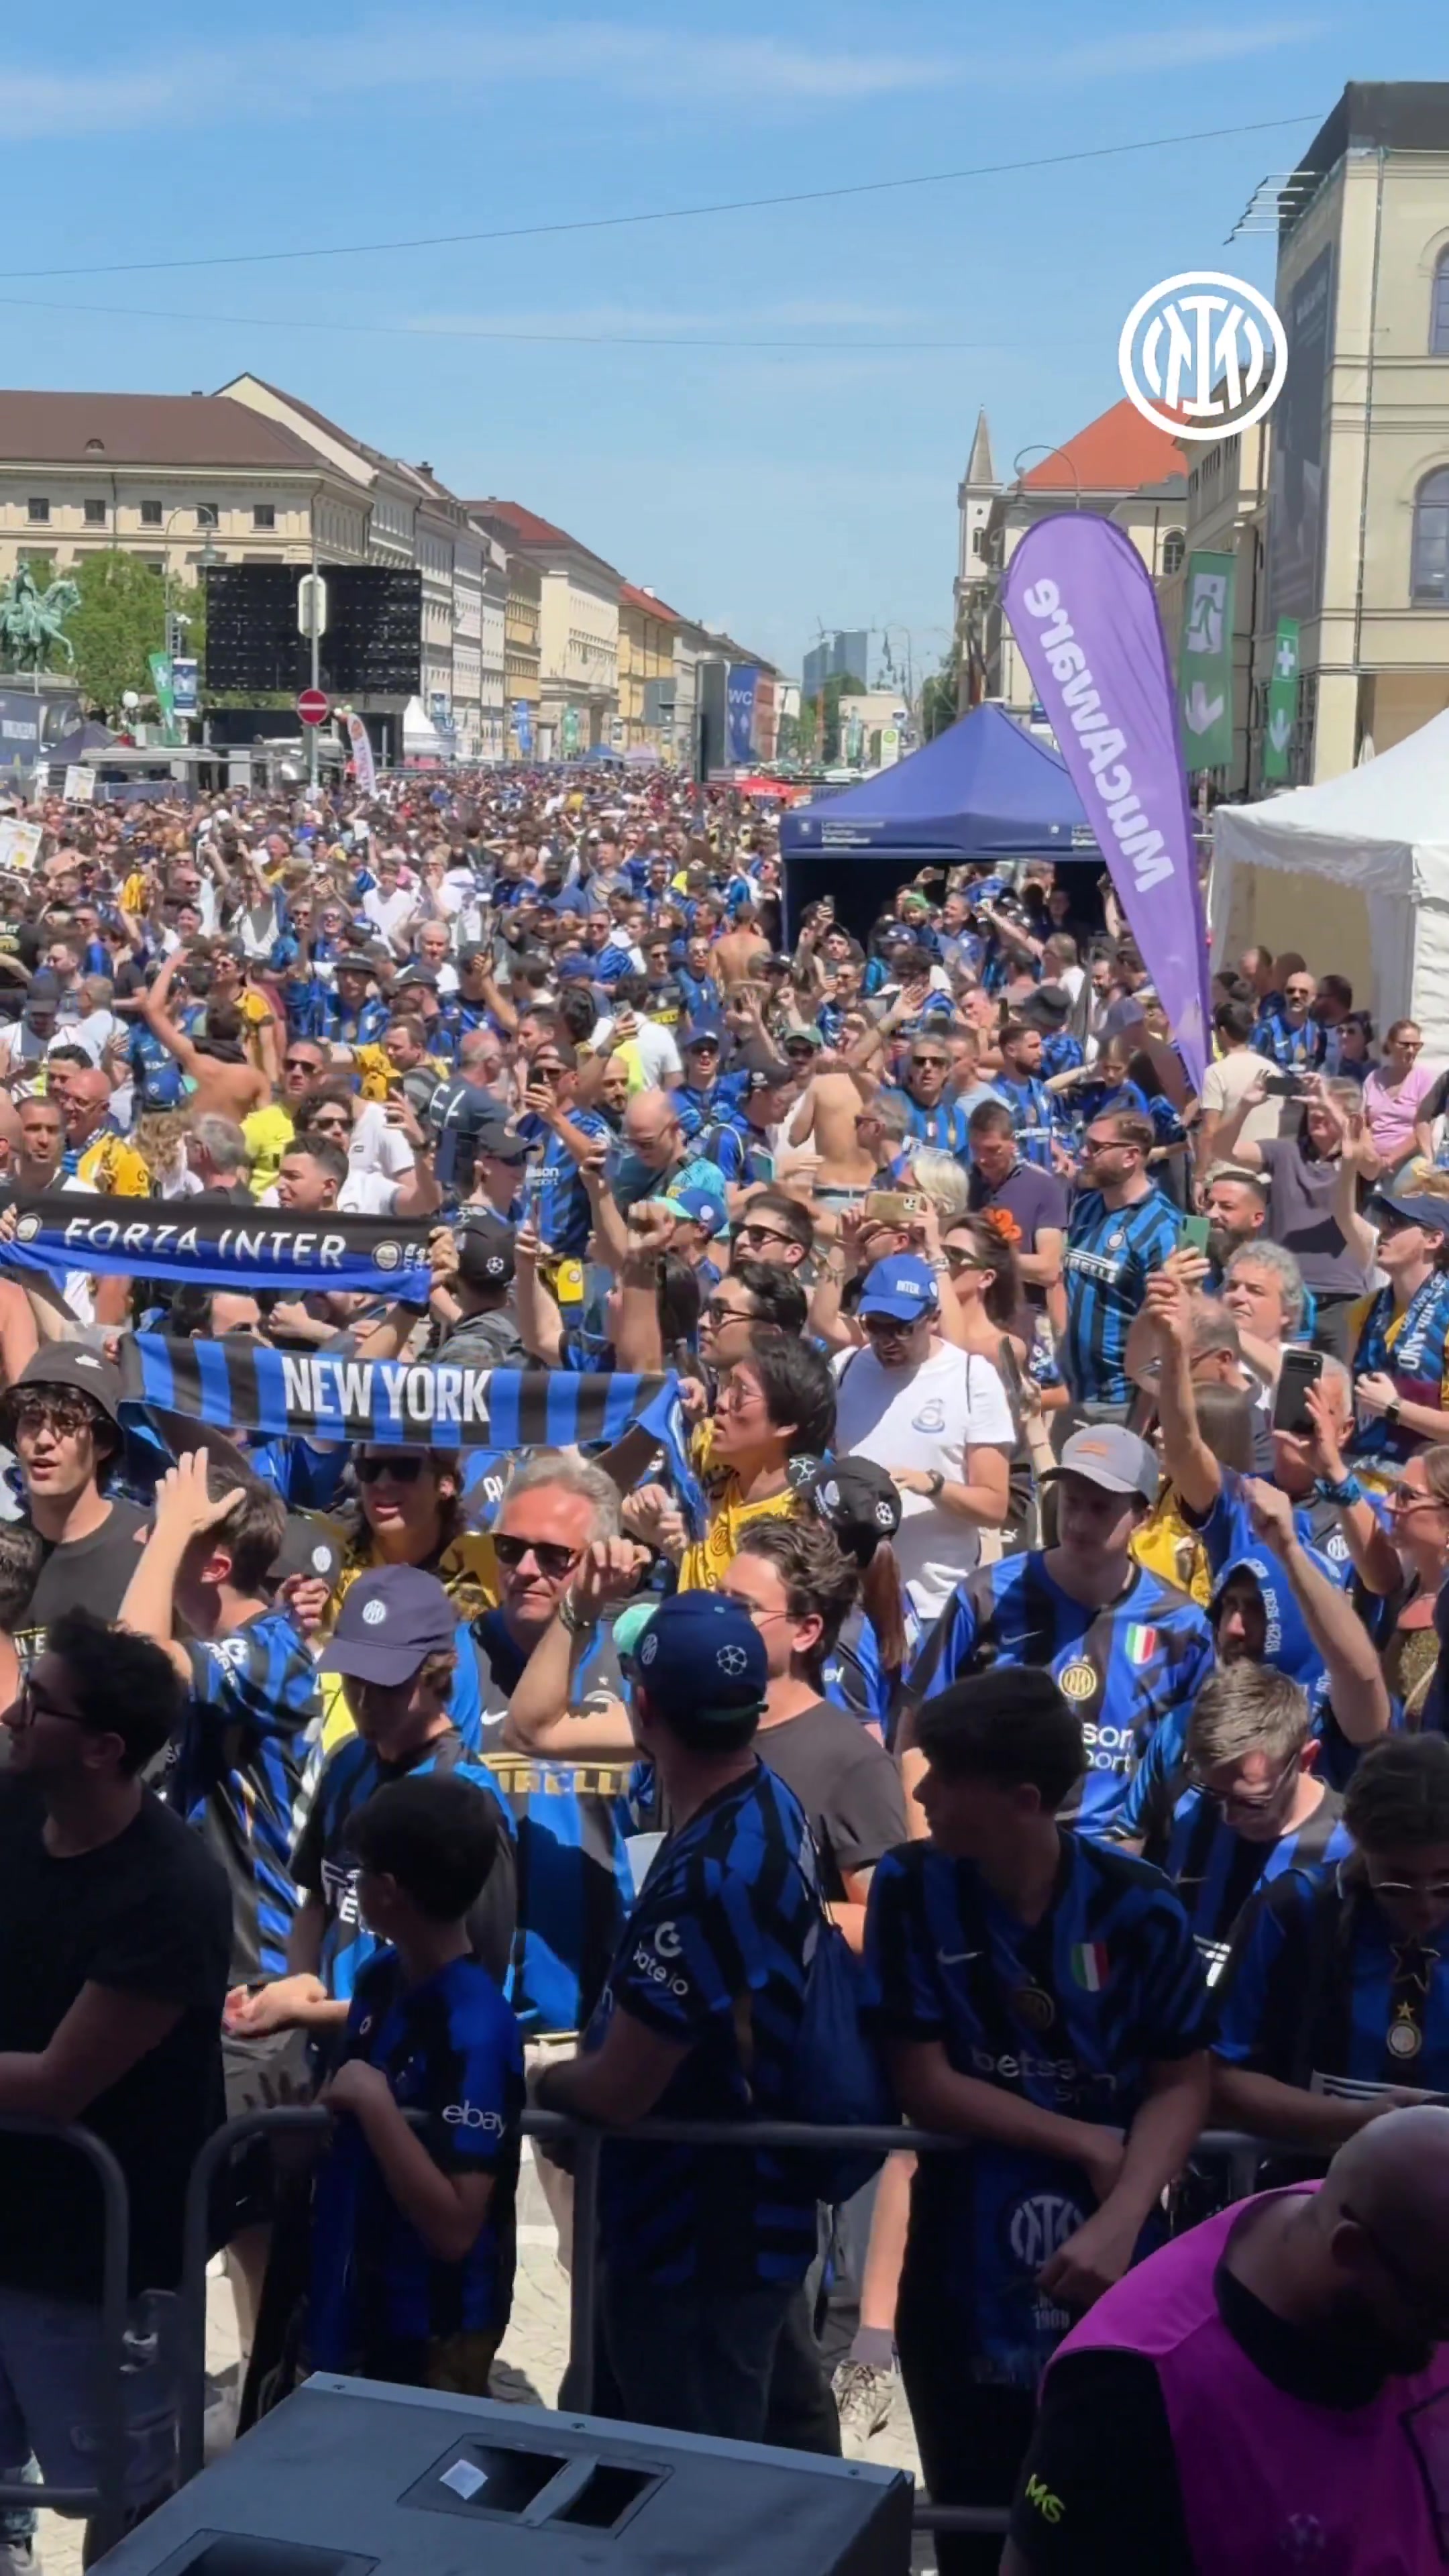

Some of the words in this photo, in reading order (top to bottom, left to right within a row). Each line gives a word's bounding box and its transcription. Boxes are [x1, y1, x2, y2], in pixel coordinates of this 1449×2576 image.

[728, 689, 753, 705] WC
[64, 1217, 201, 1258] FORZA
[217, 1228, 347, 1269] INTER
[1063, 1248, 1119, 1284] IRELLI
[280, 1356, 374, 1417] NEW
[380, 1365, 493, 1422] YORK
[441, 2098, 506, 2140] ebay
